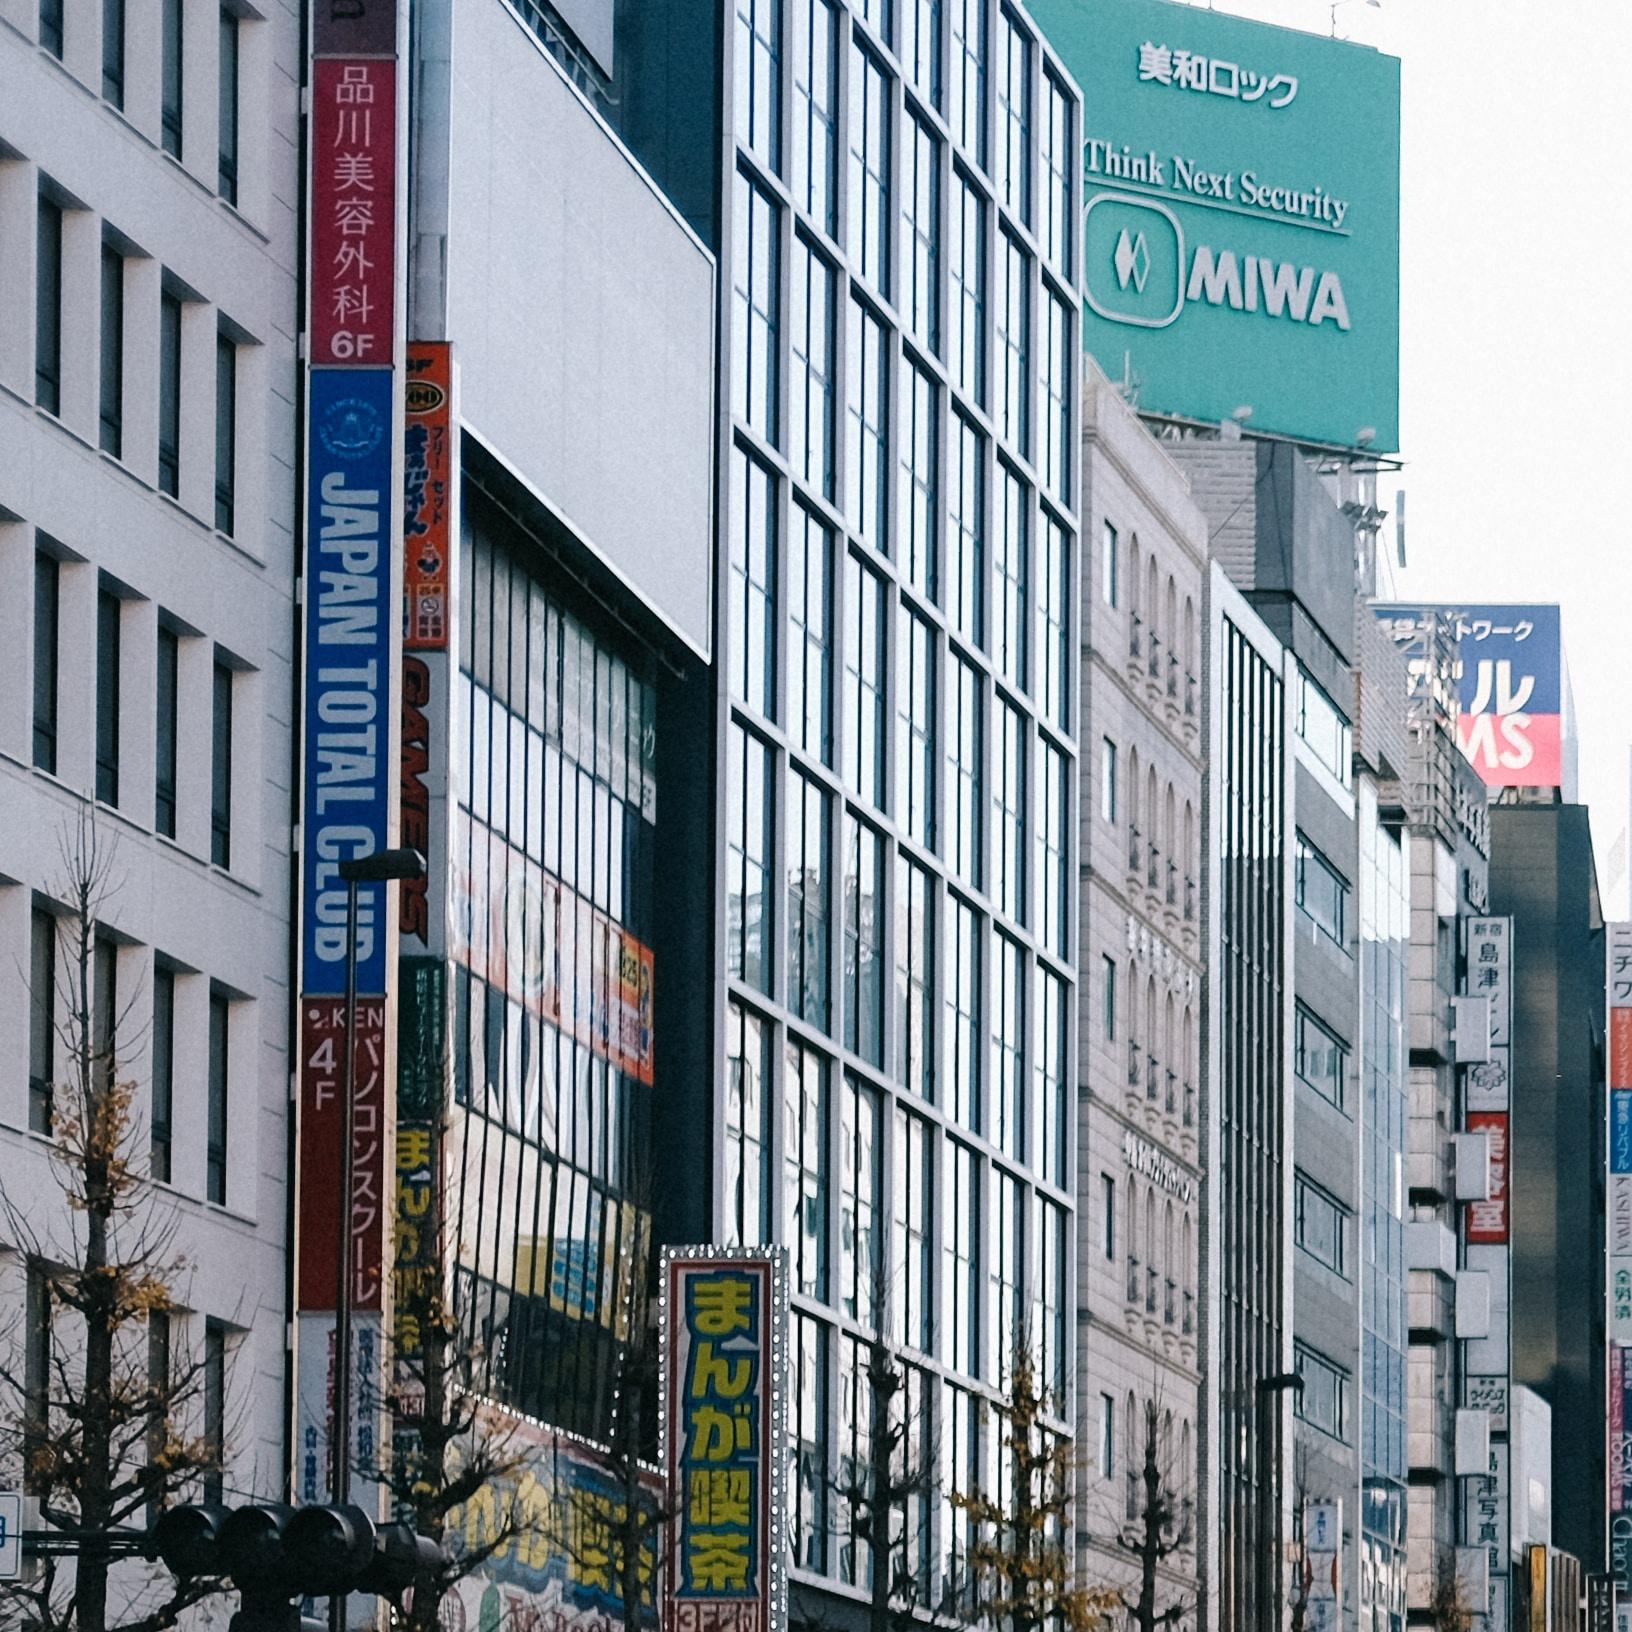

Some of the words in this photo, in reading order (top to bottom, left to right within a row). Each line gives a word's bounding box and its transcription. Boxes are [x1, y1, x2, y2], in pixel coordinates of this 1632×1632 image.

[1139, 40, 1299, 109] 美和ロック
[333, 66, 375, 325] 品川美容外科
[1082, 138, 1166, 187] Think
[1172, 156, 1235, 203] Next
[1240, 171, 1349, 230] Security
[1187, 245, 1351, 332] MIWA
[331, 329, 375, 359] 6F
[318, 472, 380, 647] JAPAN
[316, 658, 378, 816] TOTAL
[1613, 931, 1632, 999] ニチワ
[333, 1007, 382, 1029] KEN
[690, 1278, 752, 1592] まんが喫茶
